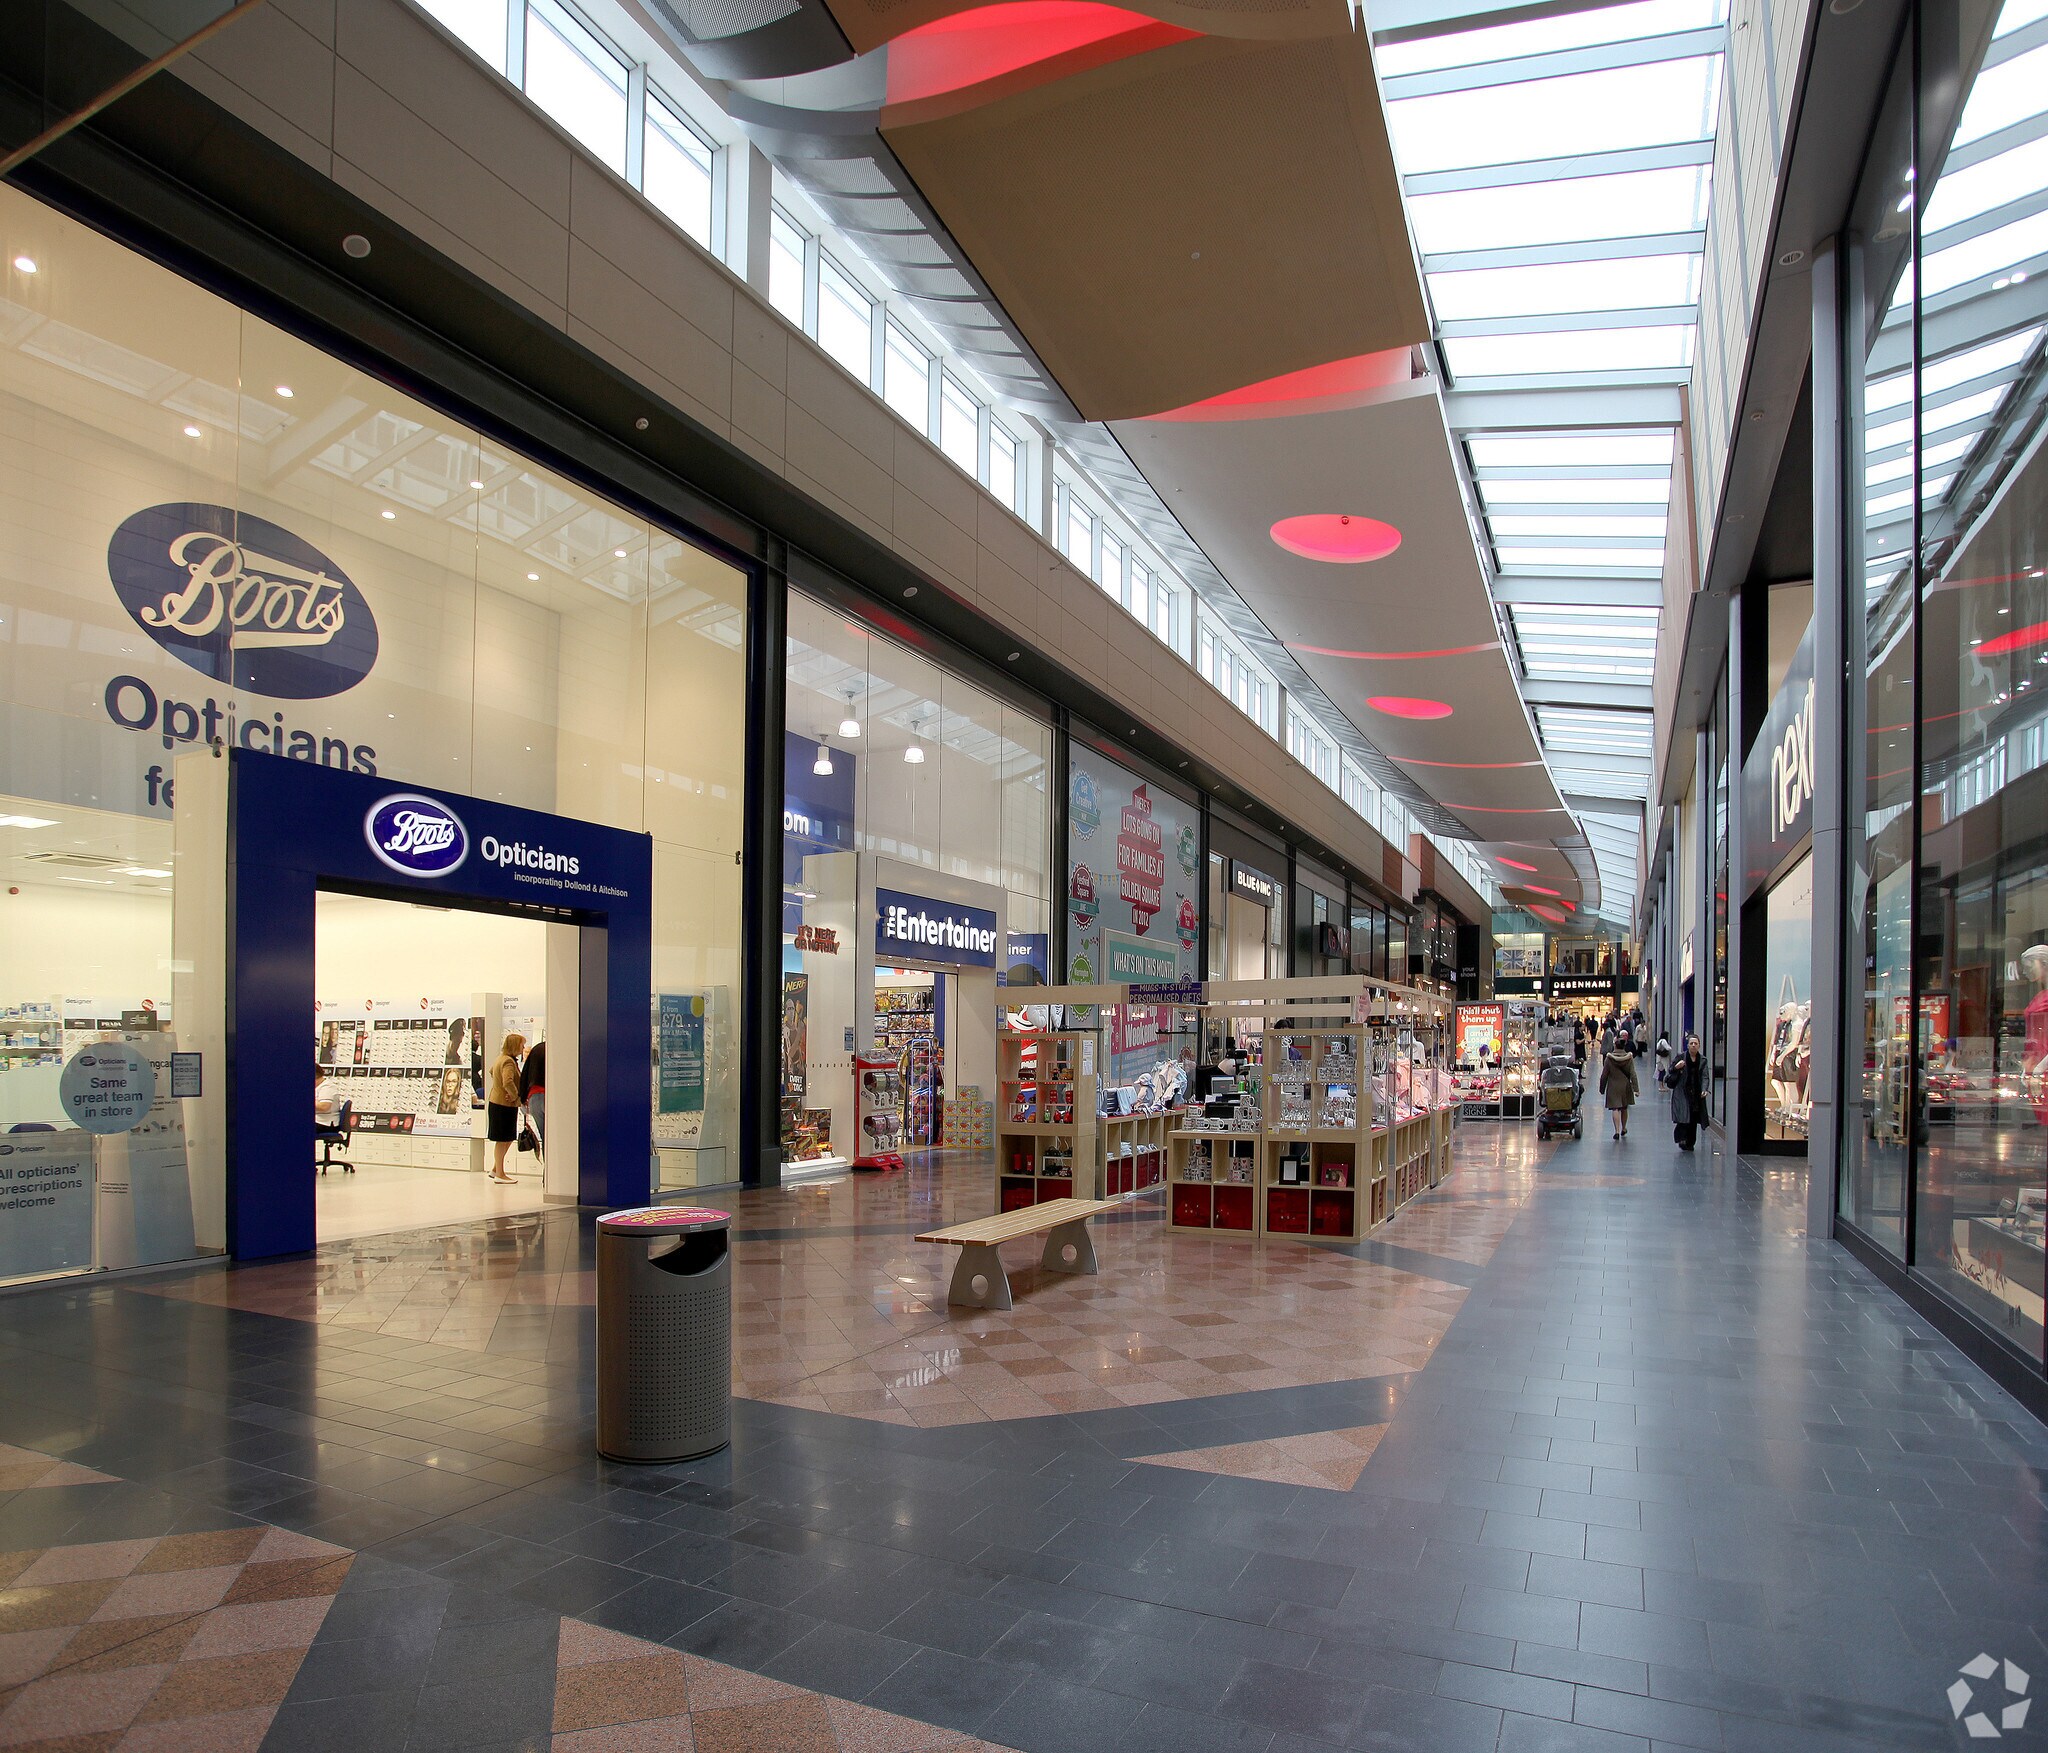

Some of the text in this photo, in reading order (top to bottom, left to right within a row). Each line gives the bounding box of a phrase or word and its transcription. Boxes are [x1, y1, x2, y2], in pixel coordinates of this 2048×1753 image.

[141, 532, 344, 649] Boots
[105, 675, 377, 776] Opticians
[1772, 678, 1814, 842] next
[1134, 795, 1150, 814] THERE'S
[384, 811, 455, 855] Boots
[1123, 811, 1160, 845] LOTS GOING ON
[481, 836, 579, 875] Opticians
[1118, 843, 1164, 879] FOR FAMILIES AT
[514, 872, 628, 898] incorporating Dollond & Aitchison
[1121, 879, 1160, 907] GOLDEN SQUARE
[1237, 871, 1271, 897] BLUE INC
[1132, 907, 1149, 927] IN 2012
[887, 905, 997, 953] The Entertainer
[1113, 950, 1174, 979] WHAT'S ON THIS MONTH
[785, 979, 807, 993] NERF
[1139, 983, 1192, 992] MUGS-N-STUFF
[1553, 980, 1612, 989] DEBENHAMS
[1129, 993, 1201, 1004] PERSONALISED GIFTS
[1457, 1006, 1501, 1015] This'll shut
[1461, 1015, 1497, 1024] them up
[90, 1077, 127, 1088] Same
[73, 1092, 143, 1105] great team
[85, 1106, 133, 1117] in store
[359, 1120, 375, 1128] save
[0, 1163, 80, 1180] All opticians'
